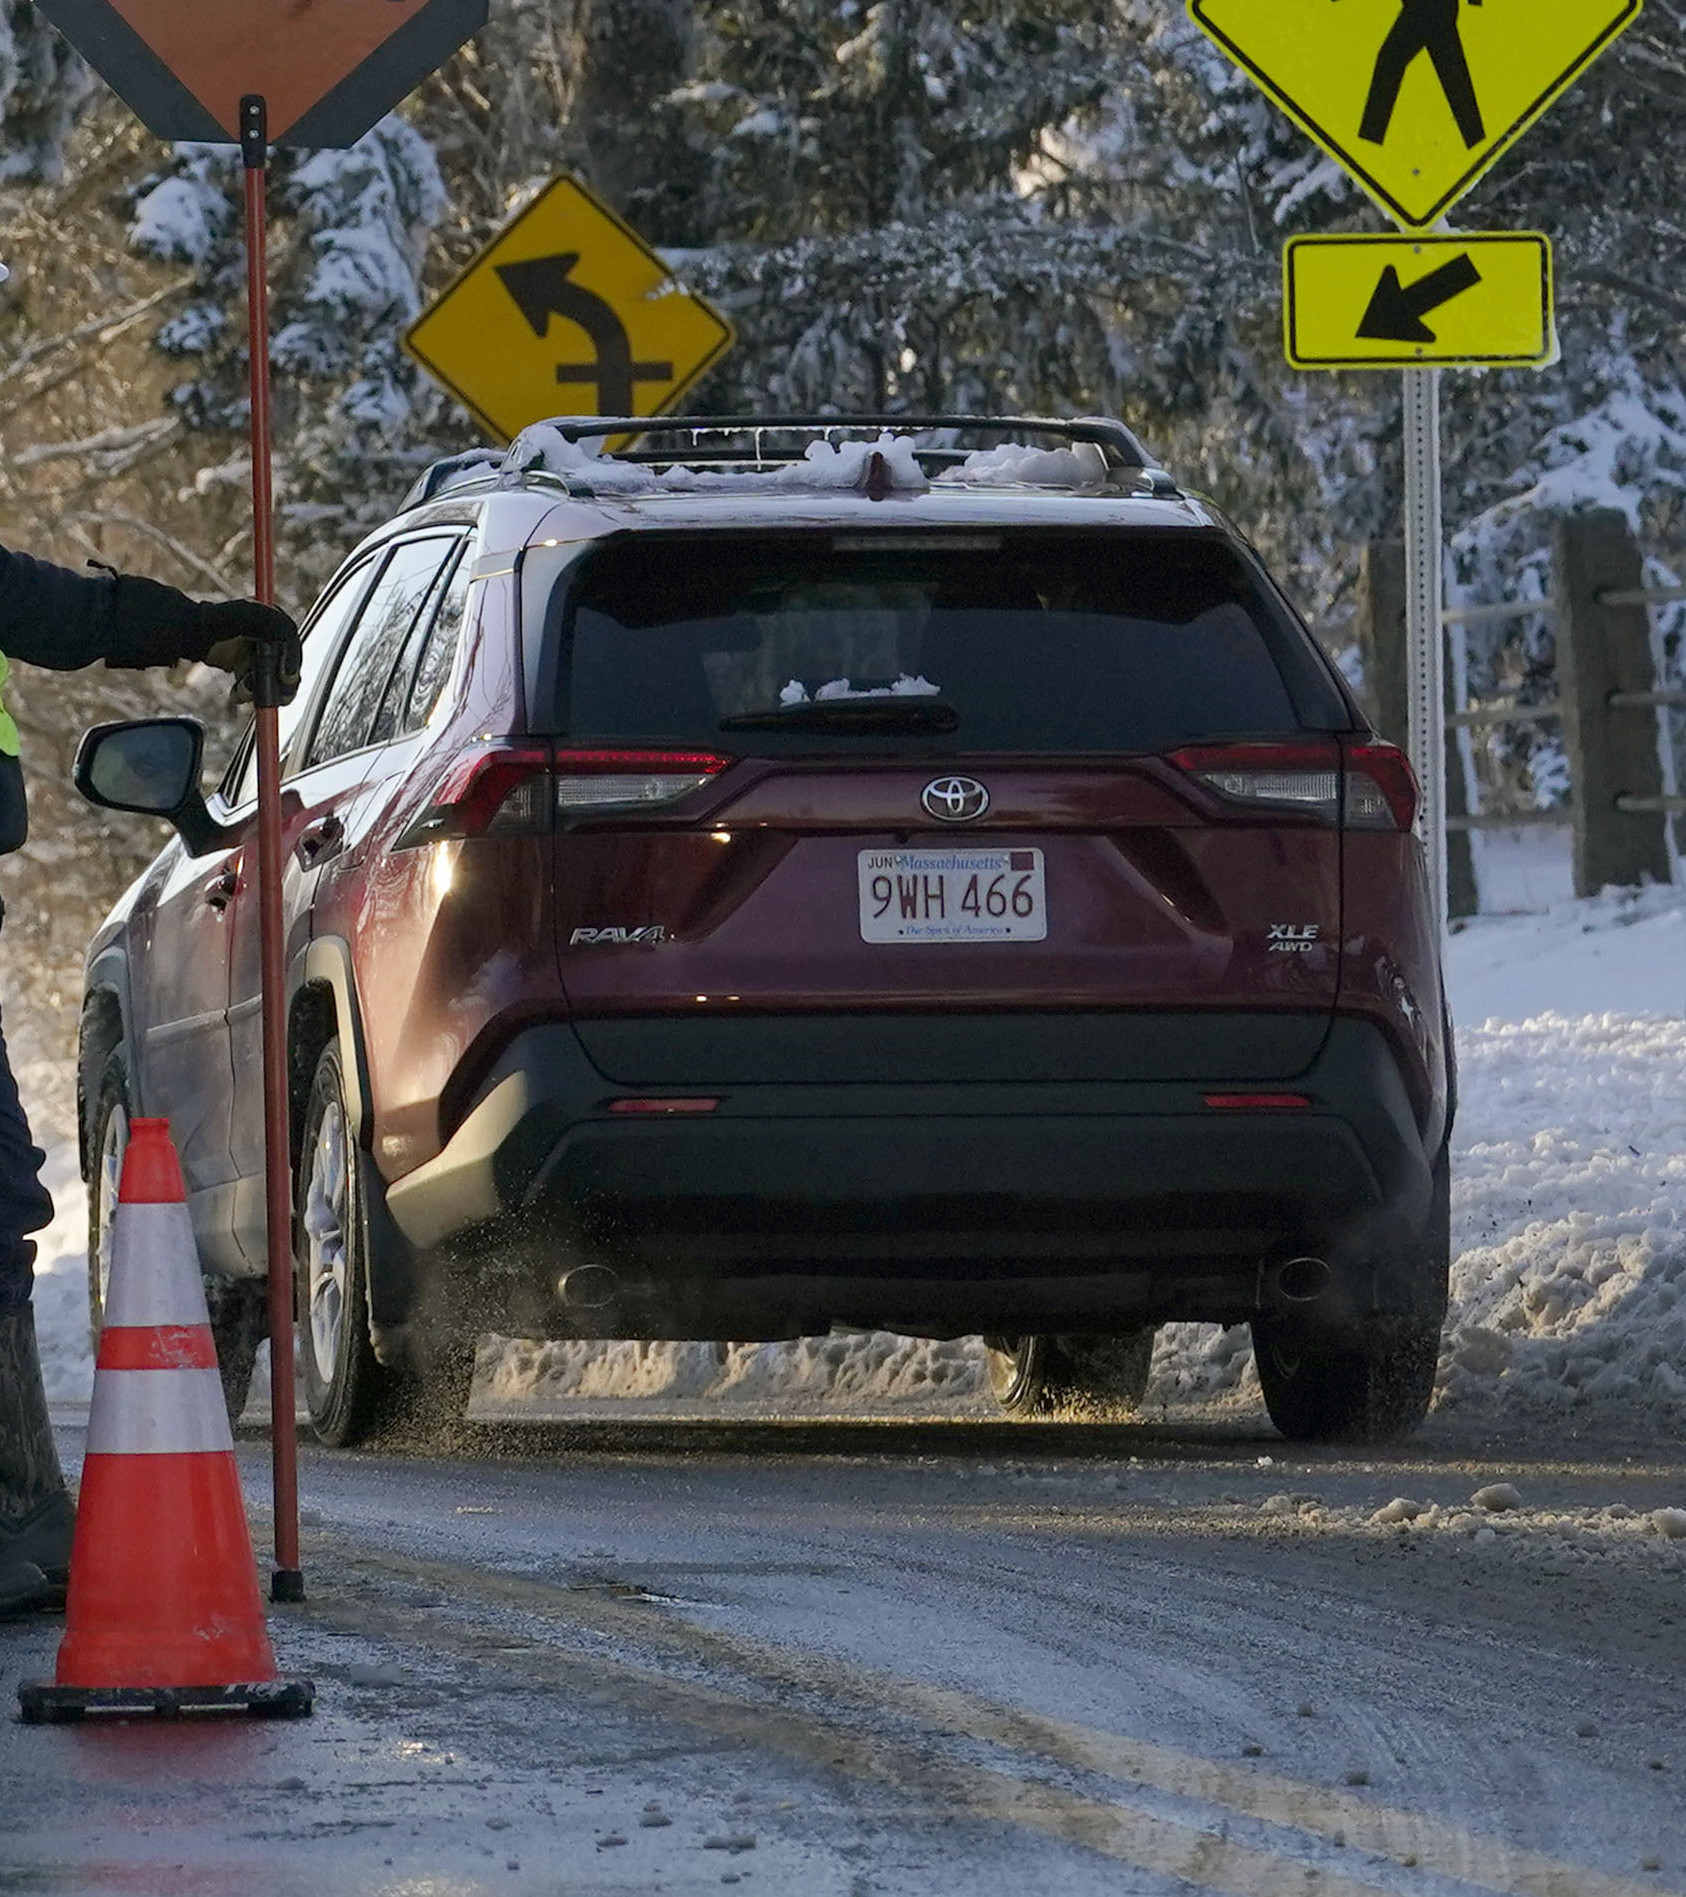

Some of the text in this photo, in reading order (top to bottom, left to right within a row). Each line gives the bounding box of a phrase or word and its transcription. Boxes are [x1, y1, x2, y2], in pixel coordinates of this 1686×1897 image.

[868, 854, 1002, 870] JUN Massachusetts
[872, 874, 1034, 919] 9WH 466
[569, 925, 665, 945] RAV4
[1267, 924, 1319, 939] XLE
[1268, 941, 1314, 952] AWD
